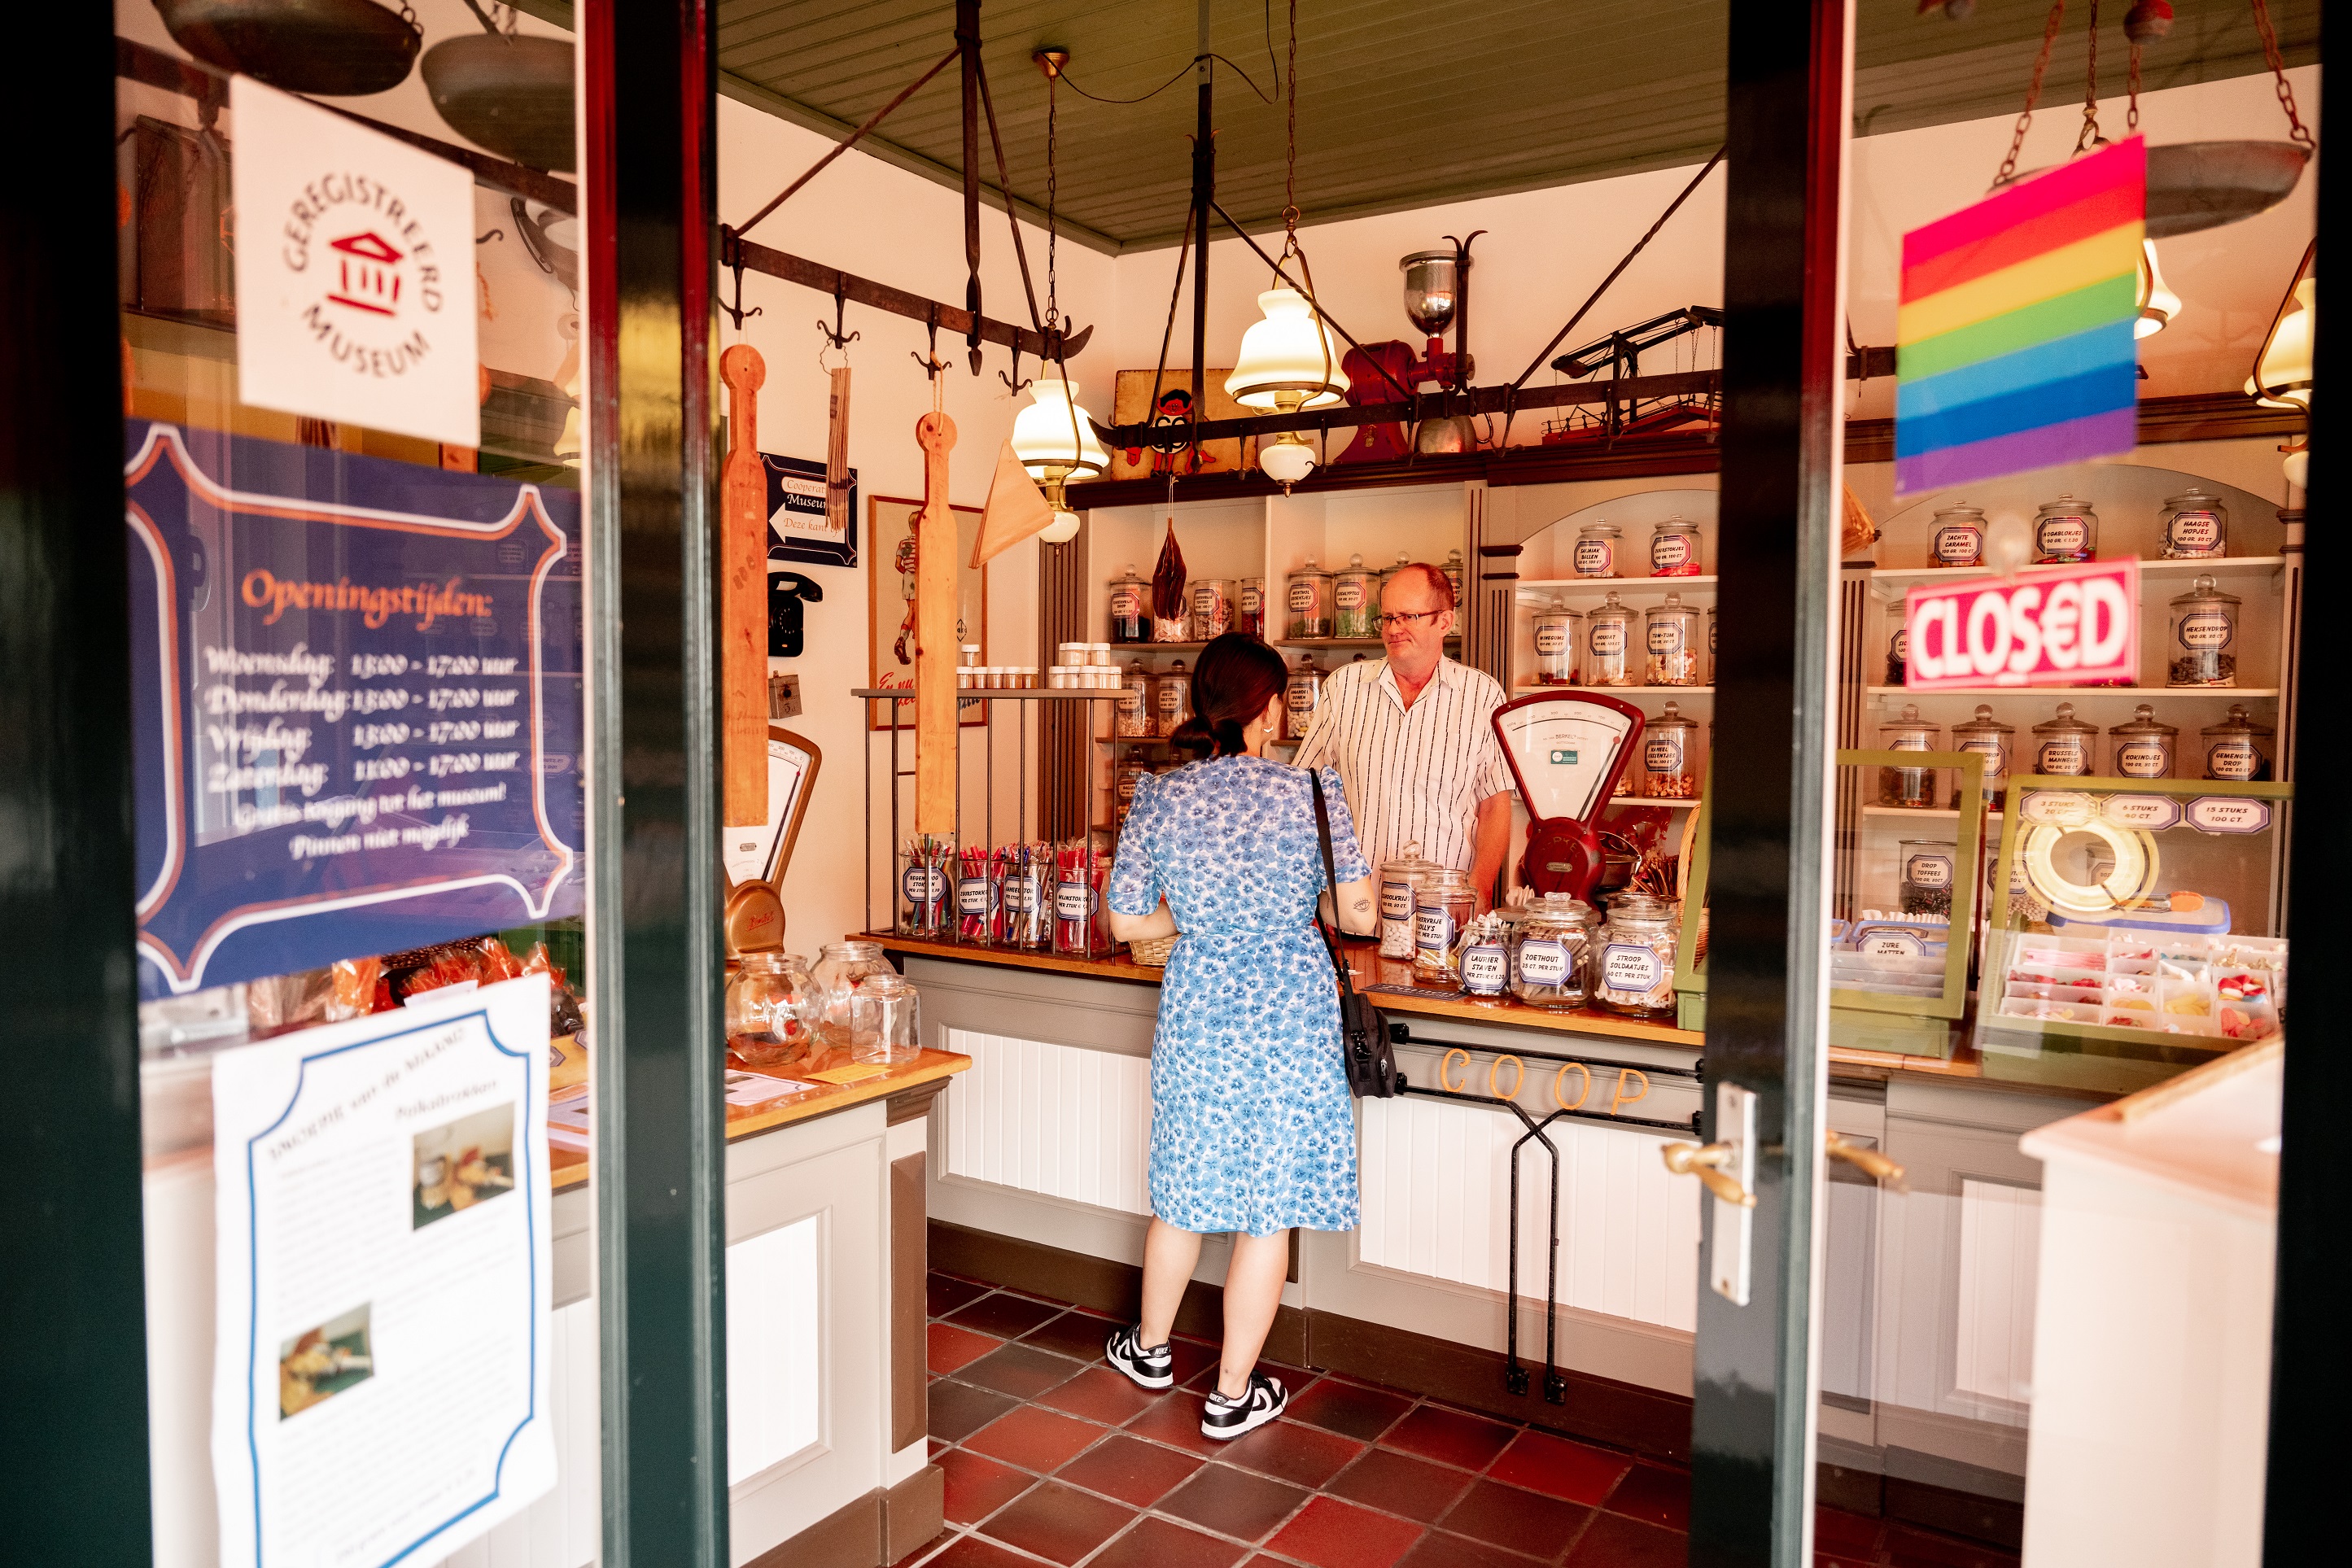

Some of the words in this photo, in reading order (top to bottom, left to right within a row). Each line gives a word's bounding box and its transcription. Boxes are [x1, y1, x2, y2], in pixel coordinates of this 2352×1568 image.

[282, 172, 444, 314] GEREGISTREERD
[302, 304, 431, 378] MUSEUM
[784, 518, 805, 530] Deze
[242, 569, 493, 631] Openingstijden:
[482, 657, 518, 676] uur
[483, 688, 518, 707] uur
[483, 719, 519, 739] uur
[483, 751, 519, 771] uur
[1471, 955, 1498, 963] LAURIER
[1525, 954, 1559, 963] ZOETHOUT
[1610, 962, 1649, 971] SOLDAATJES
[1616, 954, 1642, 963] STROOP
[1155, 1347, 1169, 1355] NIKE
